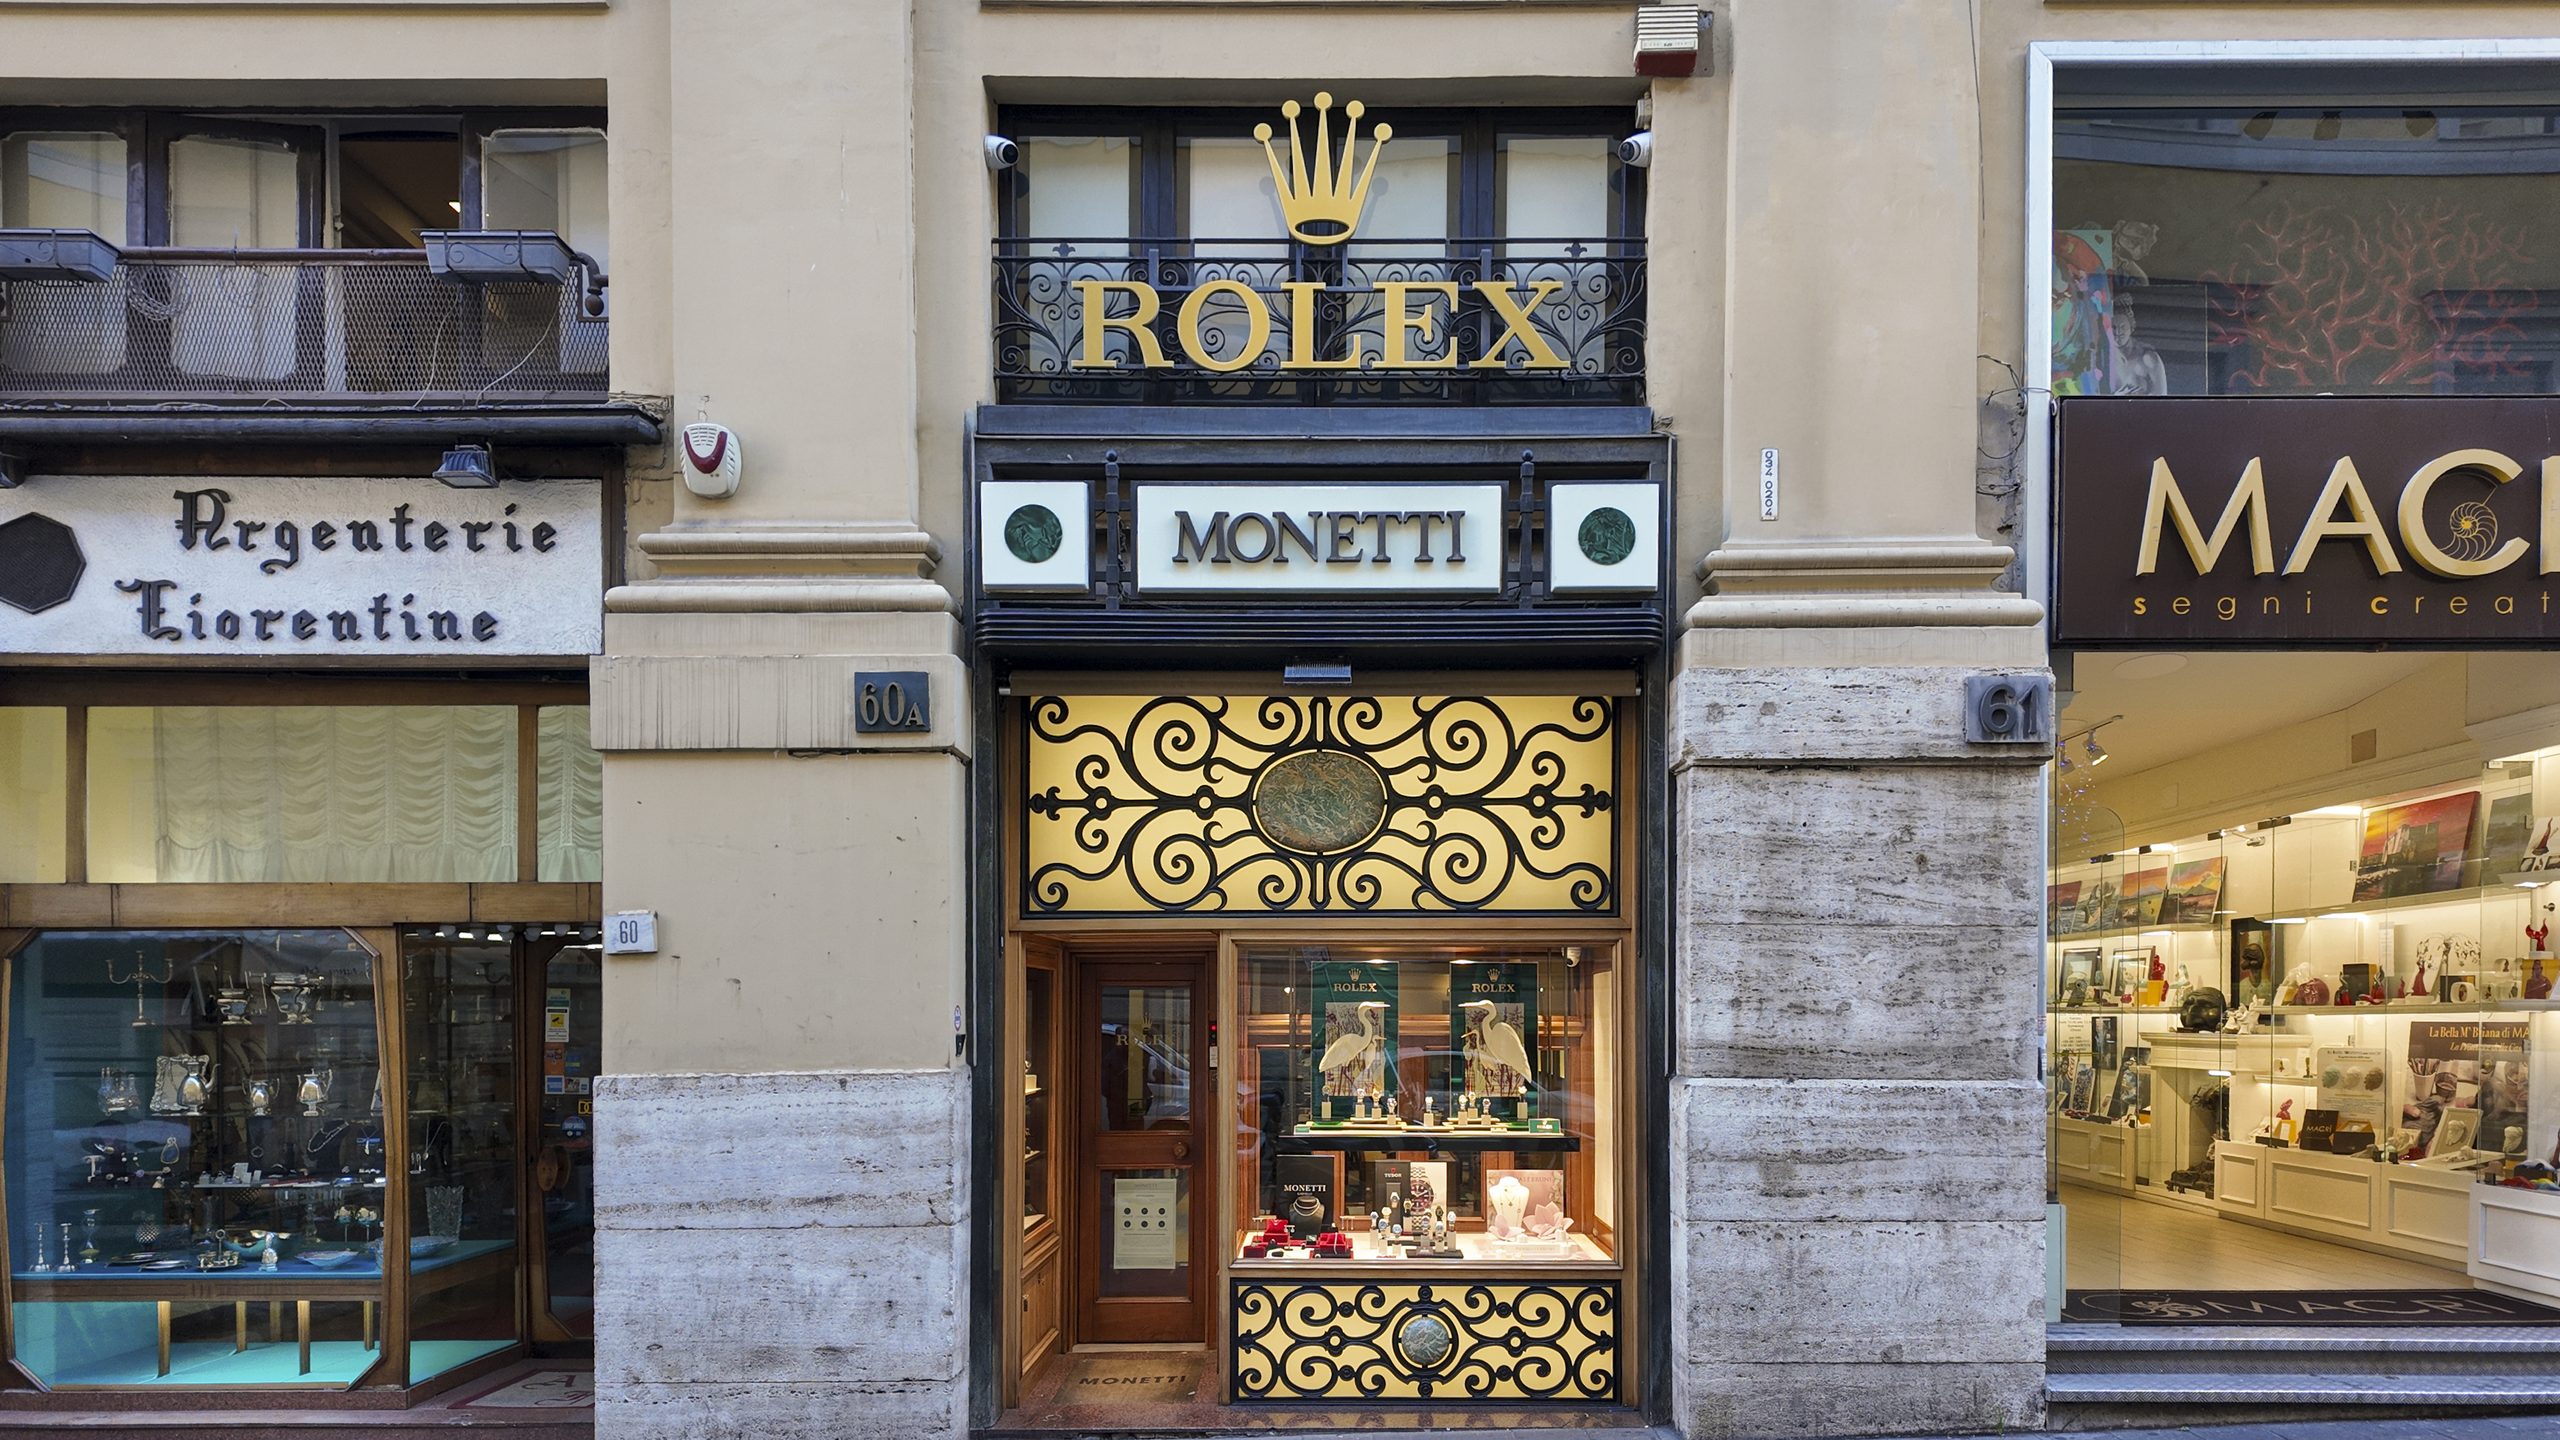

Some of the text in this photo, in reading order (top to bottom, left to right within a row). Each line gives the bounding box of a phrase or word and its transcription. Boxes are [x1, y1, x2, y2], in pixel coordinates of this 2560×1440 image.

[1071, 280, 1571, 371] ROLEX
[1765, 450, 1773, 516] 034 0204
[172, 488, 557, 574] Argenterie
[1171, 509, 1466, 564] MONETTI
[114, 578, 499, 641] Fiorentine
[2133, 590, 2550, 621] segni creat
[1978, 684, 2038, 735] 61
[619, 920, 638, 944] 60
[1333, 983, 1377, 993] ROLEX
[1471, 983, 1516, 993] ROLEX
[2429, 1026, 2439, 1038] La
[2440, 1026, 2459, 1038] Bella
[2501, 1027, 2511, 1038] di
[1284, 1184, 1326, 1192] MONETTI
[1079, 1375, 1187, 1385] MONETTI
